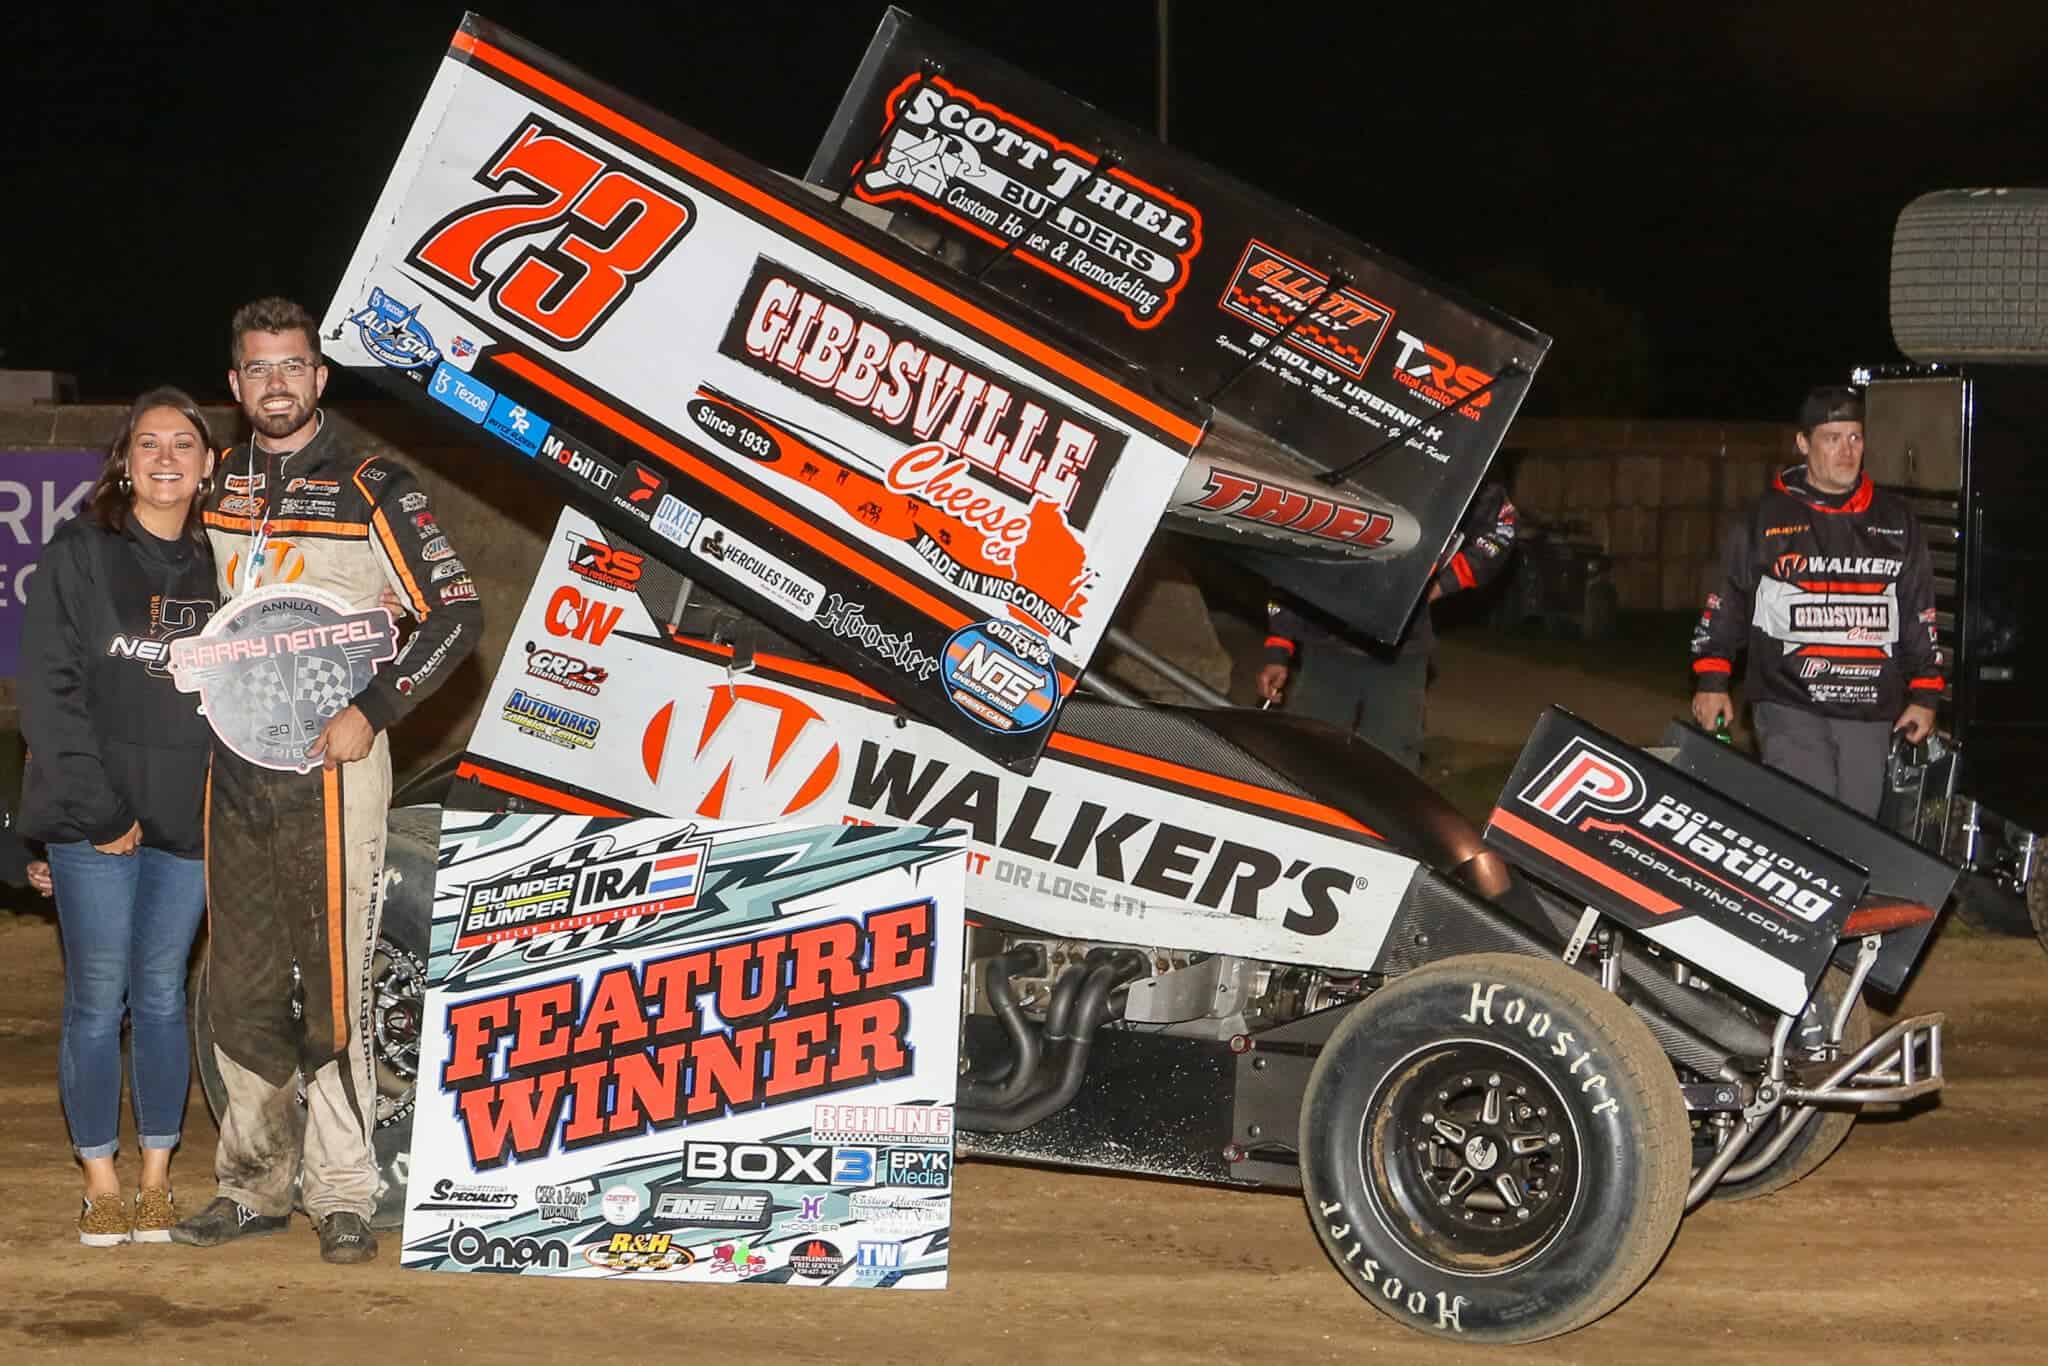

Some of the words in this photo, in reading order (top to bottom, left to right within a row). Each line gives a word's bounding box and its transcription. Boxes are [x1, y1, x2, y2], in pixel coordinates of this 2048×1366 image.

[901, 87, 1048, 170] SCOTT
[1047, 157, 1189, 247] THIEL
[408, 114, 696, 350] 73
[947, 187, 998, 226] Custom
[1002, 214, 1049, 252] Hoes
[1050, 241, 1067, 261] &
[1067, 249, 1160, 314] Remodeling
[357, 310, 386, 335] ALL
[396, 337, 437, 362] STAR
[1396, 330, 1497, 408] TRS
[453, 380, 488, 412] Tezos
[744, 278, 1100, 509] GIBBSVILLE
[1392, 367, 1422, 391] Total
[697, 404, 738, 438] Since
[737, 426, 772, 457] 1933
[542, 435, 594, 479] Mobil
[657, 495, 700, 536] DIXIE
[887, 444, 1029, 543] Cheese
[1194, 467, 1394, 549] THIEL
[566, 530, 645, 581] TRS
[656, 522, 683, 545] VODKA
[440, 583, 477, 600] King
[724, 543, 783, 587] HERCULES
[779, 576, 815, 608] TIRES
[916, 535, 960, 580] MADE
[957, 570, 980, 593] IN
[979, 574, 1073, 637] WISCONSIN
[261, 601, 321, 616] ANNUAL
[544, 585, 624, 646] CW
[180, 637, 268, 667] HARRY
[272, 620, 385, 654] NEITZEL
[814, 593, 939, 681] Hoosier
[412, 644, 447, 682] STEALTH
[958, 640, 1046, 706] NOS
[1830, 664, 1881, 678] Plating
[509, 691, 599, 737] AUTOWORKS
[952, 671, 988, 696] ENERGY
[986, 691, 1016, 713] DRINK
[986, 710, 1010, 728] CARS
[1639, 804, 1835, 923] Plating
[1658, 793, 1845, 898] PROFESSIONAL
[473, 874, 575, 908] BUMPER
[580, 861, 653, 908] IRA
[487, 902, 506, 912] TO
[995, 859, 1032, 888] OR
[1036, 872, 1108, 908] LOSE
[1112, 896, 1147, 919] IT!
[1609, 838, 1803, 944] PROPLATING.COM
[466, 898, 570, 932] BUMPER
[486, 928, 538, 944] OUTLAW
[550, 915, 601, 931] SPRINT
[613, 903, 666, 919] SERIES
[442, 900, 932, 1086] FEATURE
[1461, 982, 1619, 1115] Hoosier
[458, 997, 910, 1168] WINNER
[815, 1104, 951, 1135] BEHLING
[877, 1134, 906, 1144] RACING
[907, 1135, 950, 1145] EQUIPMENT
[890, 1152, 948, 1169] EPYK
[890, 1168, 945, 1186] Media
[608, 1233, 672, 1253] R&H
[780, 1223, 840, 1232] HOOSIER
[710, 1255, 768, 1277] Sage
[859, 1243, 898, 1267] TW
[1319, 1199, 1473, 1332] Hoosier
